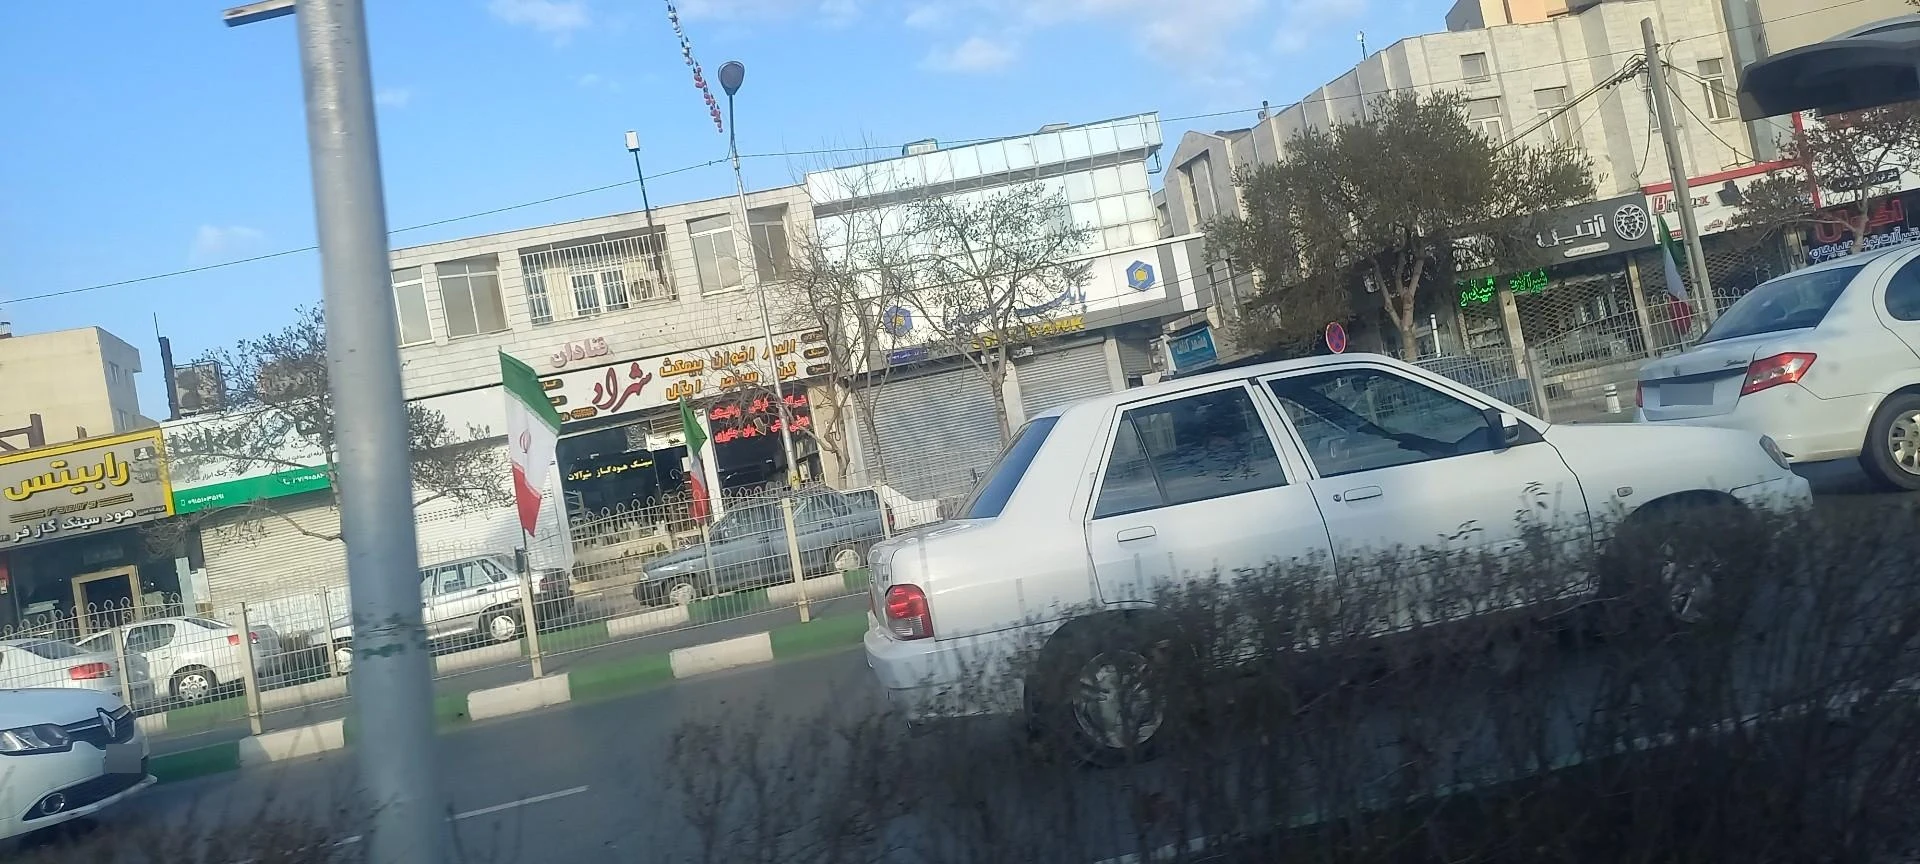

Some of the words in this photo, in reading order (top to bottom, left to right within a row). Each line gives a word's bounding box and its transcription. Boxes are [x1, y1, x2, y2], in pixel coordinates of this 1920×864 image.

[550, 336, 609, 368] قنادان
[711, 345, 755, 371] اخوان
[660, 357, 704, 378] بیمکث
[630, 458, 653, 468] سینک
[3, 452, 130, 501] رابیتس
[61, 514, 101, 530] سینک
[105, 508, 135, 523] هود
[12, 525, 31, 544] فر
[34, 517, 57, 539] گاز
